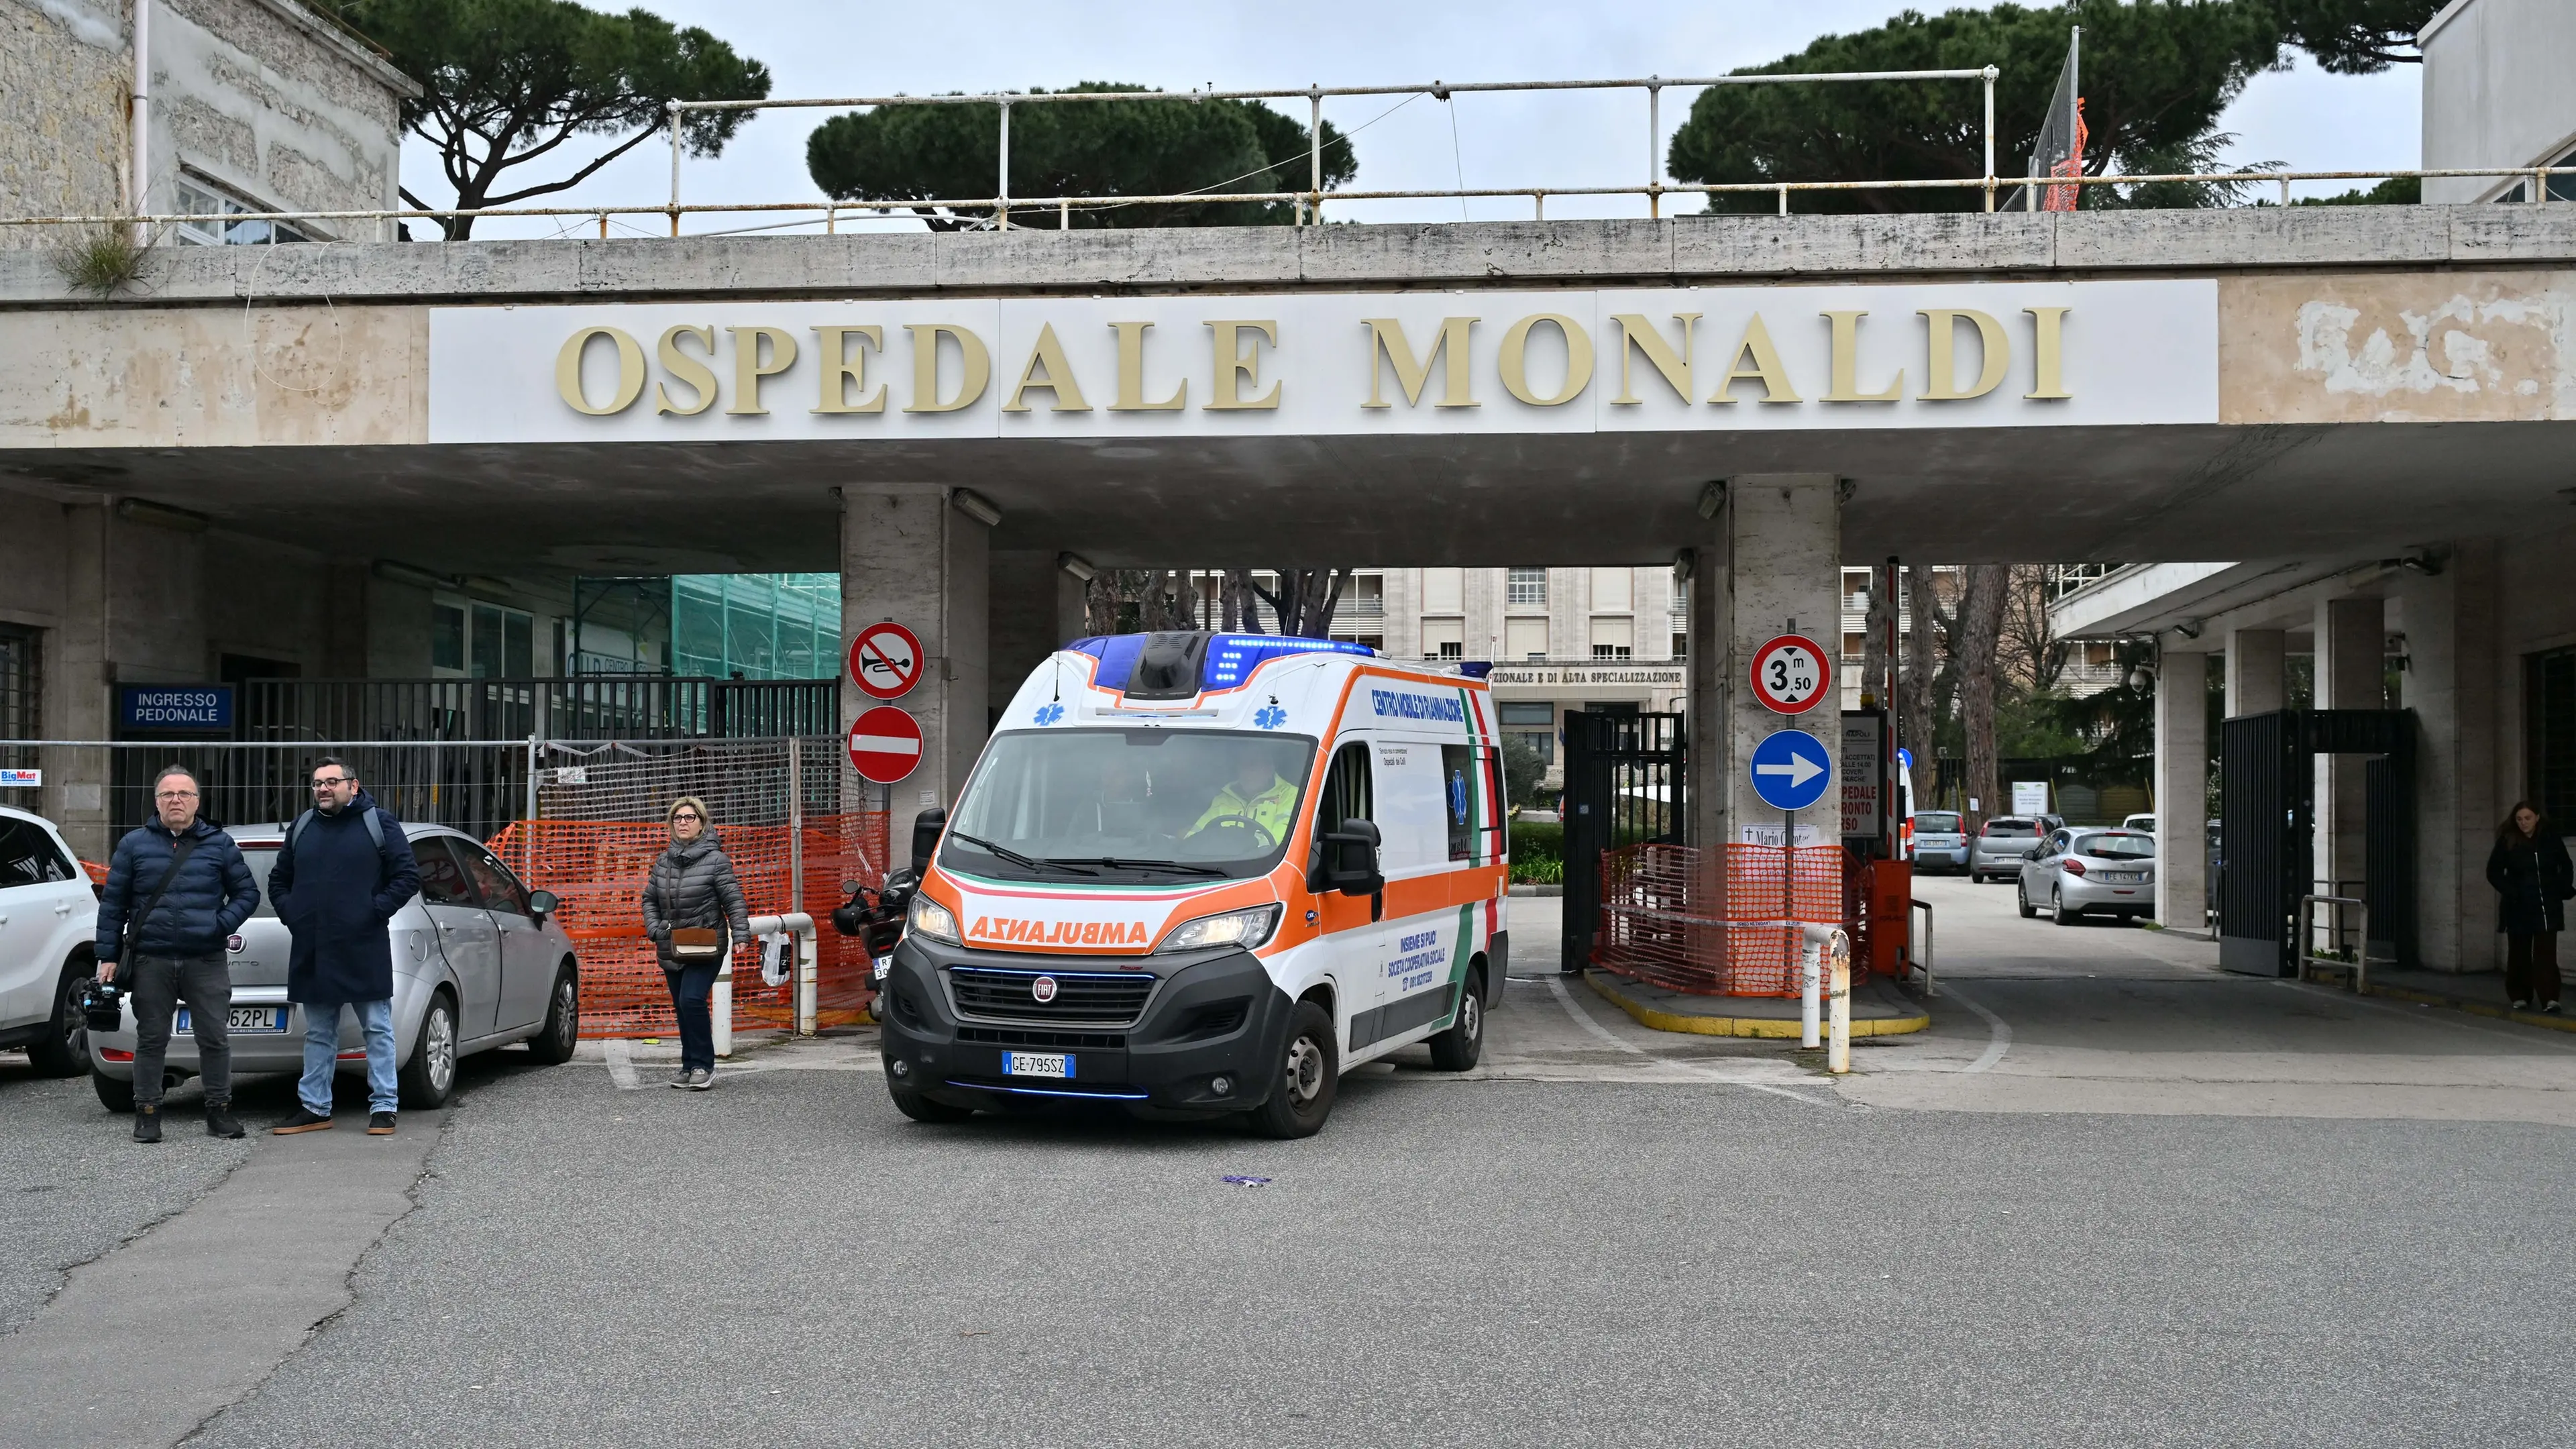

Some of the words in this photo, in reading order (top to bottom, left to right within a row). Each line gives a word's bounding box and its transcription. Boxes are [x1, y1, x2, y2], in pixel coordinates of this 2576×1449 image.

[554, 319, 1283, 417] OSPEDALE
[1360, 307, 2072, 409] MONALDI
[1794, 658, 1804, 667] m
[1494, 673, 1534, 683] ZIONALE
[1538, 673, 1543, 683] E
[1548, 673, 1557, 682] DI
[1562, 673, 1587, 682] ALTA
[1591, 672, 1681, 682] SPECIALIZZAZIONE
[1770, 660, 1788, 690] 3
[138, 693, 217, 706] INGRESSO
[1371, 689, 1399, 717] CENTRO
[1396, 692, 1420, 719] MOBILE
[136, 708, 217, 721] PEDONALE
[1, 771, 36, 781] BigMat
[1841, 786, 1876, 799] PEDALE
[1841, 802, 1872, 815] RONTO
[1756, 831, 1778, 846] Mario
[229, 939, 241, 948] FIAT
[1401, 934, 1420, 953] INSIEME
[1421, 932, 1426, 948] SI
[1405, 952, 1430, 973] COOPERATIVA
[1430, 947, 1445, 965] SOCIALE
[1038, 984, 1051, 996] FIAT
[230, 1010, 272, 1026] 62PL
